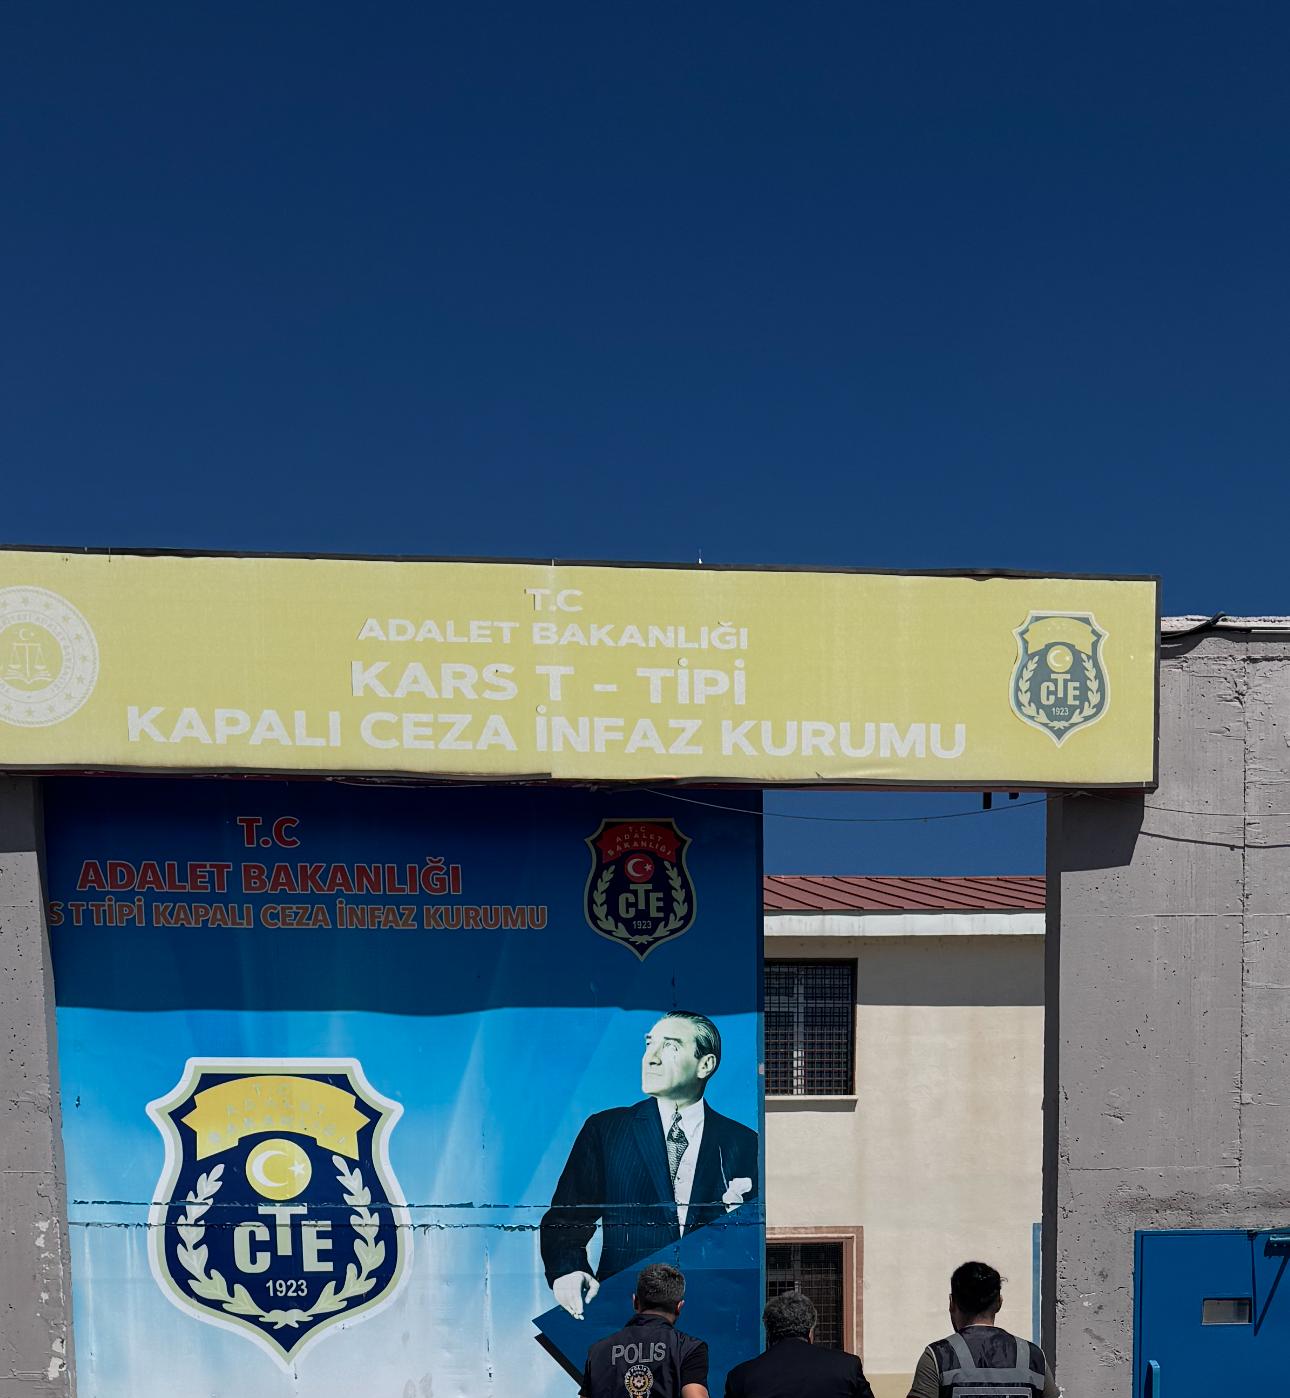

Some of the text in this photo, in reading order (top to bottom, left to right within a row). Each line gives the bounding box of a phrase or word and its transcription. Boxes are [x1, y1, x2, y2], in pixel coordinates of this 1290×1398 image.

[526, 586, 584, 612] T.C
[357, 618, 748, 650] ADALET BAKANLIĞI
[351, 660, 518, 701] KARS
[535, 665, 575, 701] T
[635, 657, 746, 705] TİPİ
[1039, 673, 1080, 706] CTE
[1051, 707, 1069, 716] 1923
[127, 704, 967, 760] KAPALI CEZA İNFAZ KURUMU
[236, 816, 301, 848] T.C
[76, 856, 462, 894] ADALET BAKANLIĞI
[68, 902, 87, 926] T
[88, 895, 145, 927] TİPİ
[152, 902, 254, 929] KAPALI
[260, 904, 332, 929] CEZA
[336, 898, 418, 929] İNFAZ
[423, 904, 549, 930] KURUMU
[618, 883, 665, 918] CTE
[632, 920, 652, 929] 1923
[233, 1202, 333, 1274] CTE
[265, 1279, 308, 1297] 1923
